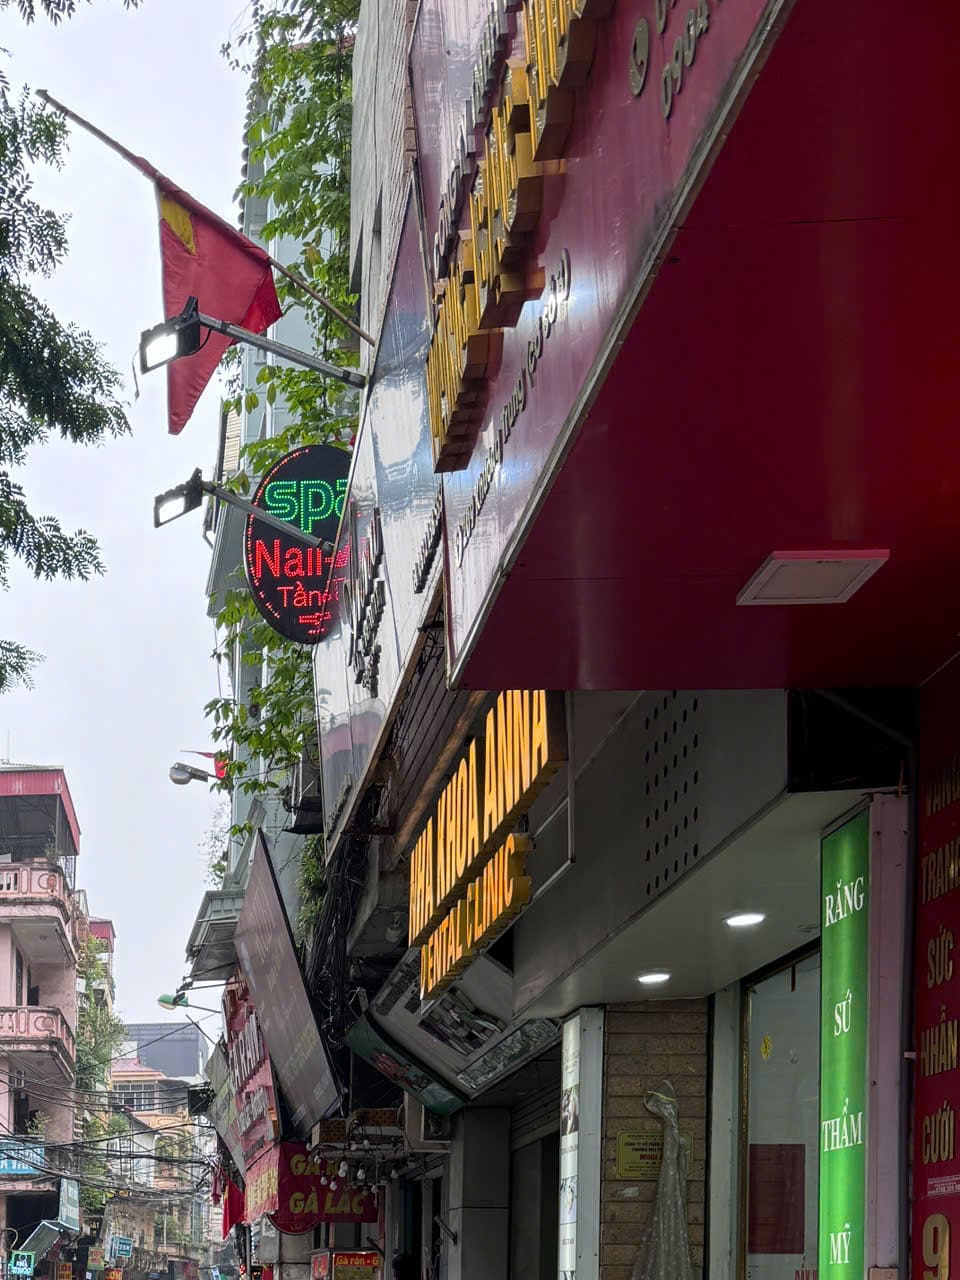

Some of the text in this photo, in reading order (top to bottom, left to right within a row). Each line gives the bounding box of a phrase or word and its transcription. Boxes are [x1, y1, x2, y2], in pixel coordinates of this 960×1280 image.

[408, 690, 549, 948] NHA KHOA ANNA
[420, 833, 515, 1000] DENTAL CLINIC
[824, 876, 865, 928] RĂNG
[927, 924, 954, 989] SỨC
[834, 988, 852, 1037] SỨ
[920, 1005, 958, 1078] NHẪN
[822, 1097, 863, 1152] THẨM
[921, 1101, 955, 1166] CƯỚI
[829, 1223, 852, 1265] MỸ
